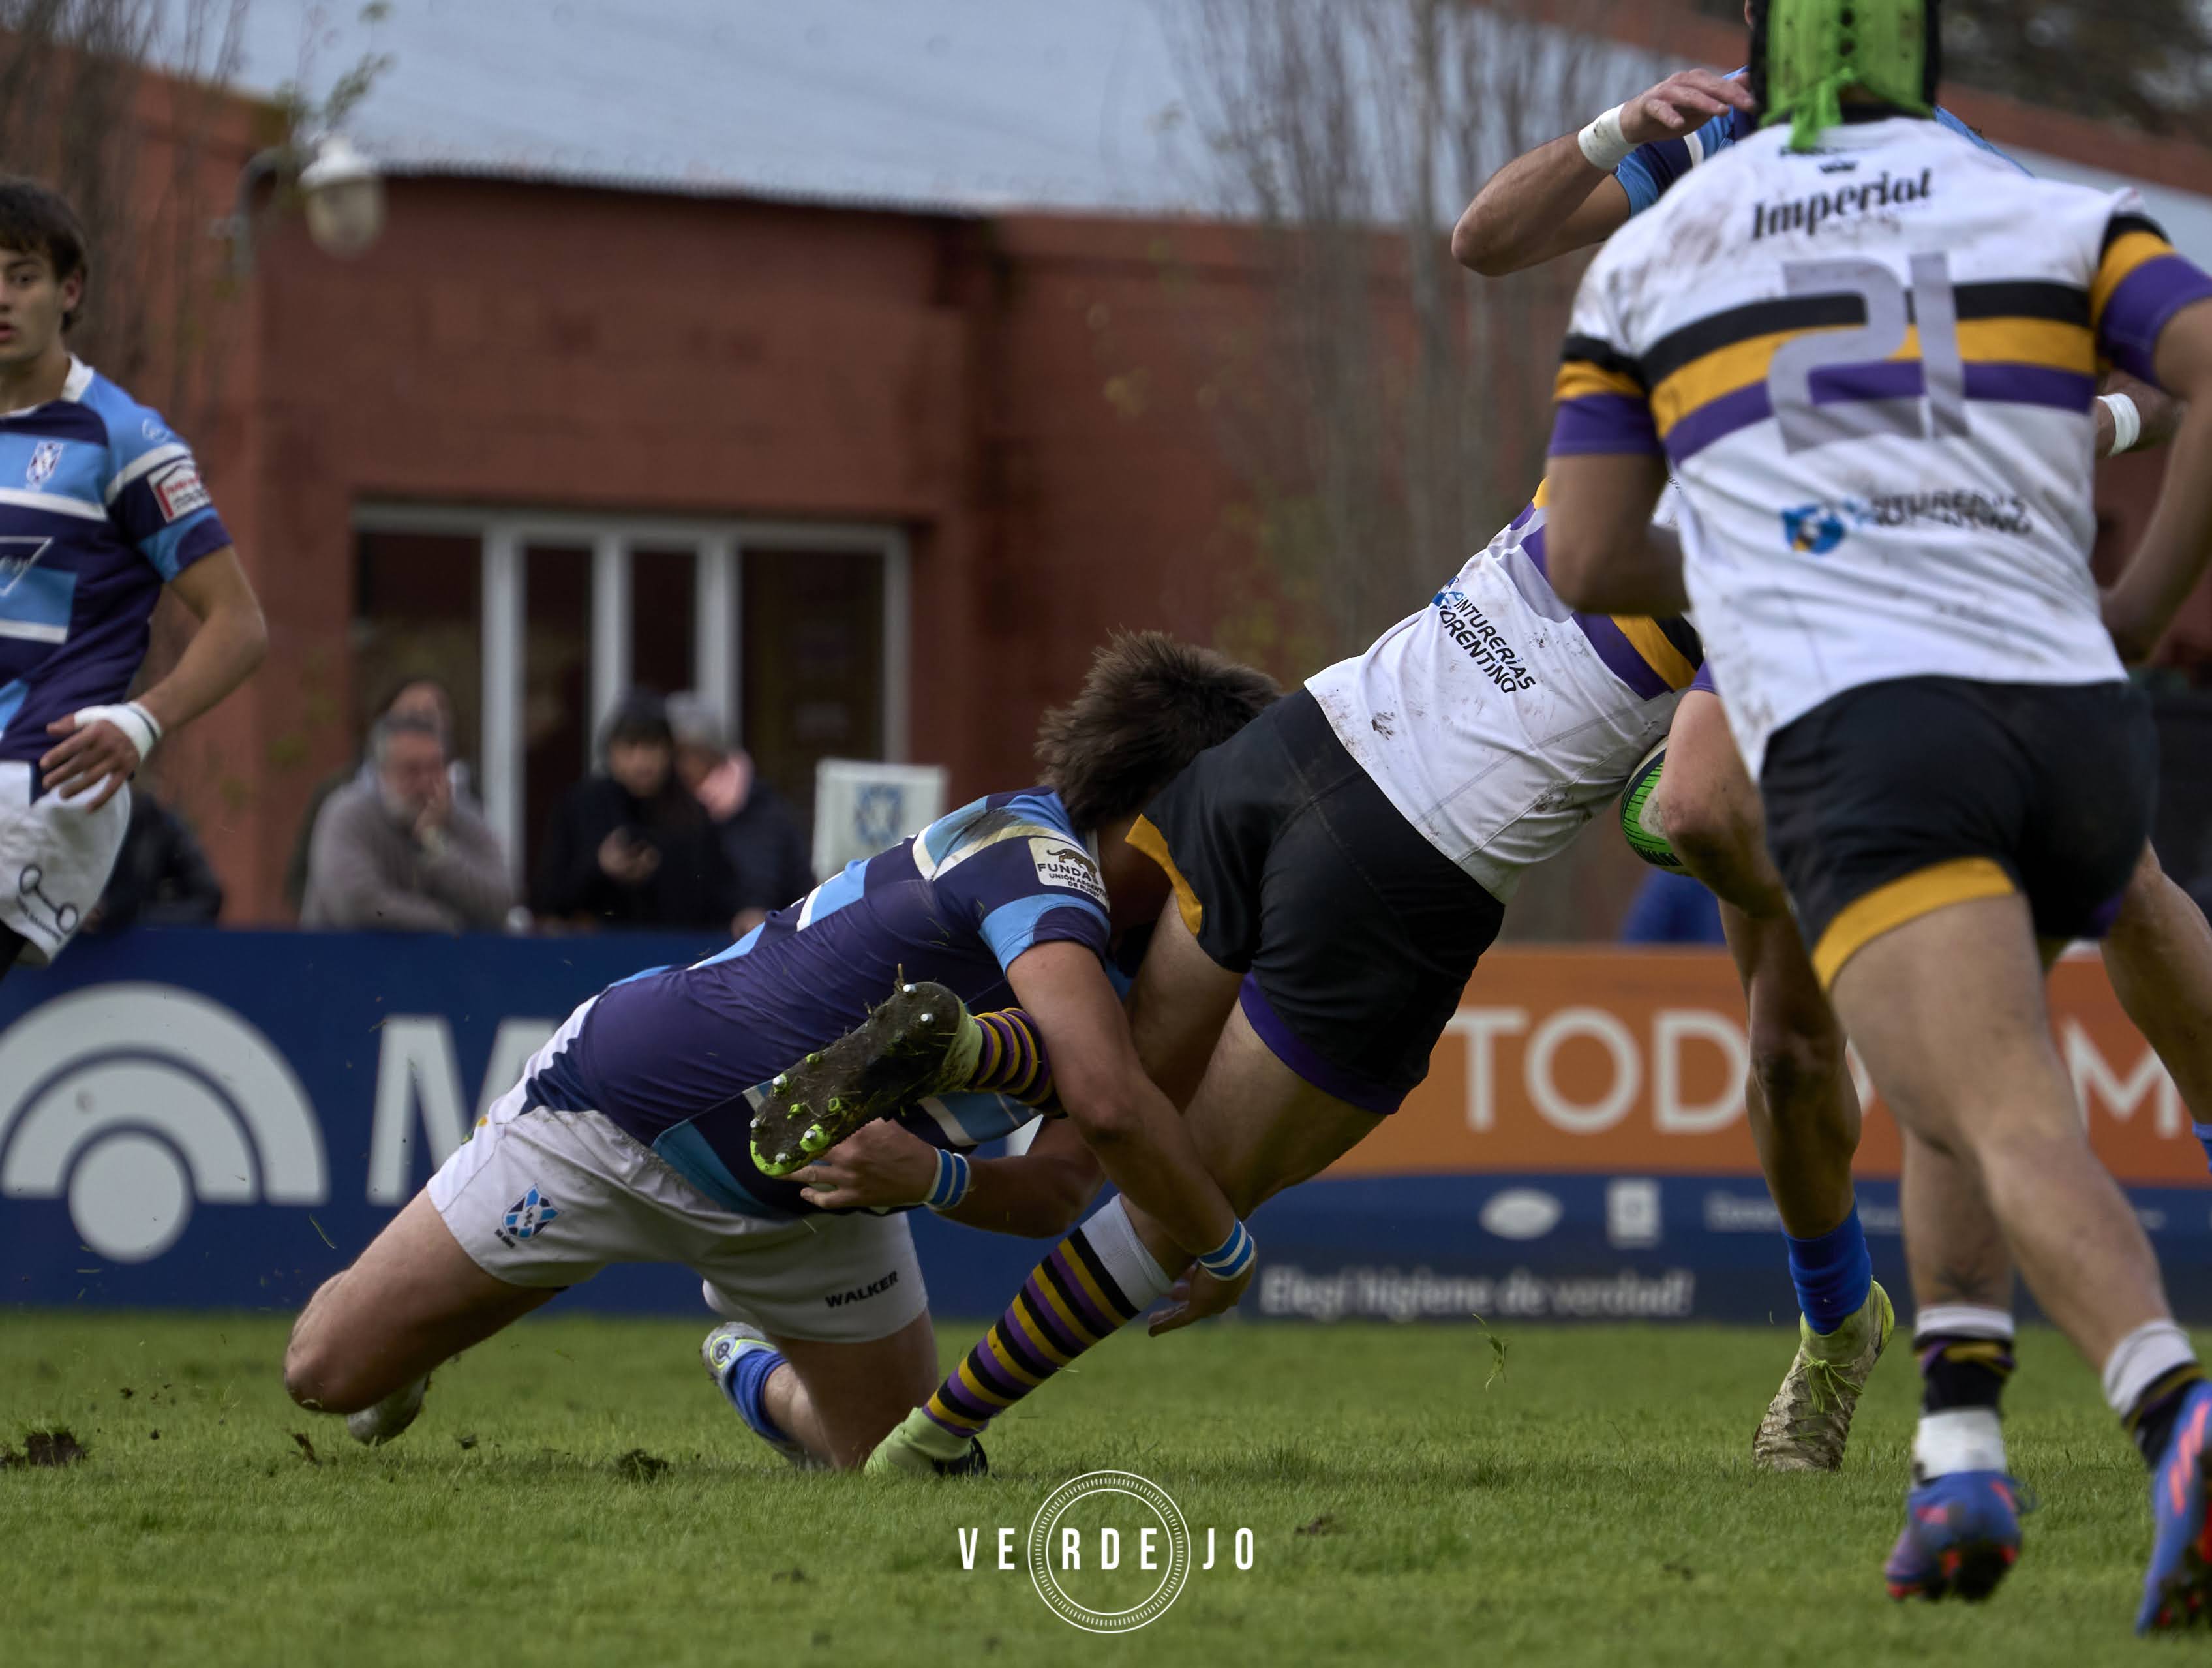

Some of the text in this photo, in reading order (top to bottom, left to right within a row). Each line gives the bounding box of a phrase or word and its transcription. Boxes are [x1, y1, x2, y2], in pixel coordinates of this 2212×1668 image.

[1753, 168, 1932, 241] Imperial
[1768, 253, 1971, 455] 21
[1037, 863, 1096, 883] FUNDA
[1440, 1006, 1874, 1134] TOD
[825, 1270, 898, 1309] WALKER
